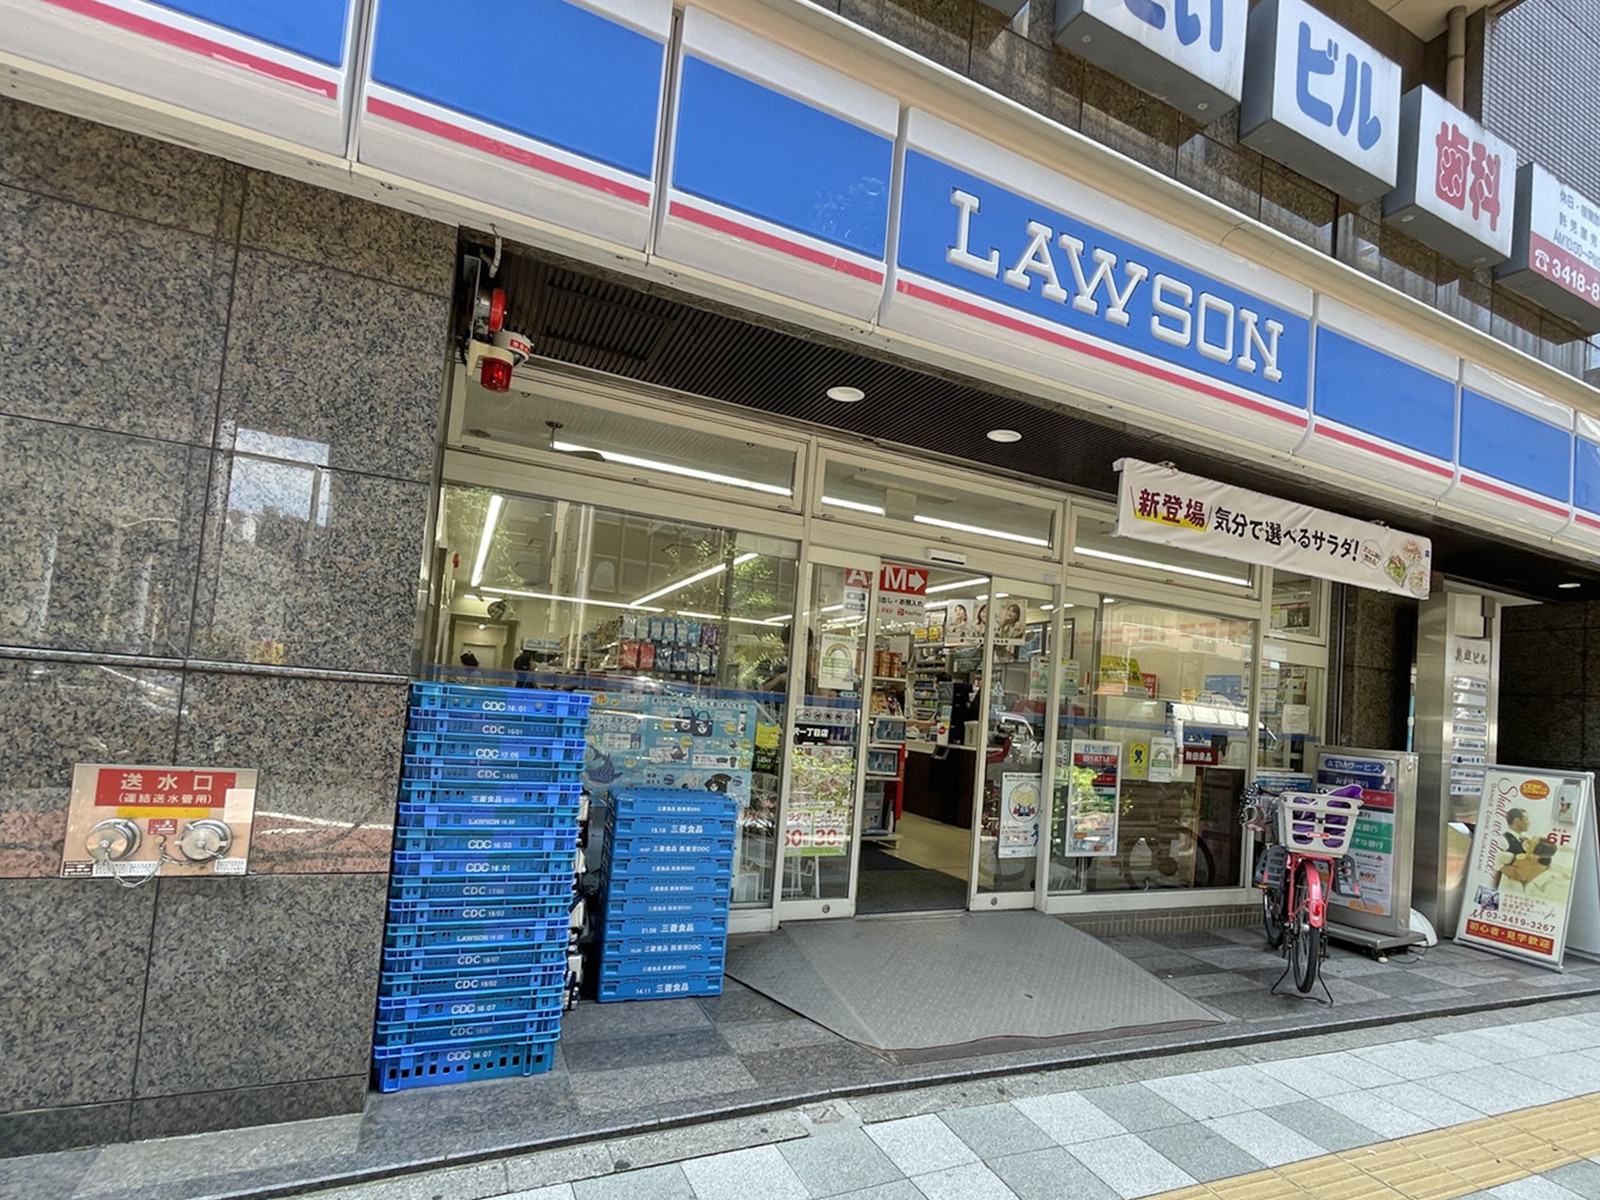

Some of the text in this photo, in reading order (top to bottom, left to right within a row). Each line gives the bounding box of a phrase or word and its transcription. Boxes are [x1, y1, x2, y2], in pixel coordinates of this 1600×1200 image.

[1296, 21, 1381, 151] ビル
[1436, 121, 1501, 231] 歯科
[945, 189, 1284, 382] LAWSON
[1138, 487, 1207, 529] 新登場
[1213, 506, 1361, 562] 気分で選べるサラダ!
[845, 566, 908, 591] AM
[482, 700, 506, 711] CDC
[482, 724, 505, 734] CDC
[475, 748, 500, 759] CDC
[477, 769, 501, 779] CDC
[121, 773, 213, 791] 送水口
[467, 839, 492, 849] CDC
[1547, 832, 1571, 846] 6F
[466, 863, 490, 872] CDC
[462, 886, 486, 895] CDC
[462, 909, 486, 918] CDC
[1486, 911, 1556, 933] 03-3419-3267
[1469, 922, 1550, 949] 初心者・見学歓迎
[457, 955, 481, 965] CDC
[455, 979, 479, 989] CDC
[451, 1003, 476, 1014] CDC
[450, 1027, 474, 1037] CDC
[447, 1050, 472, 1061] CDC
